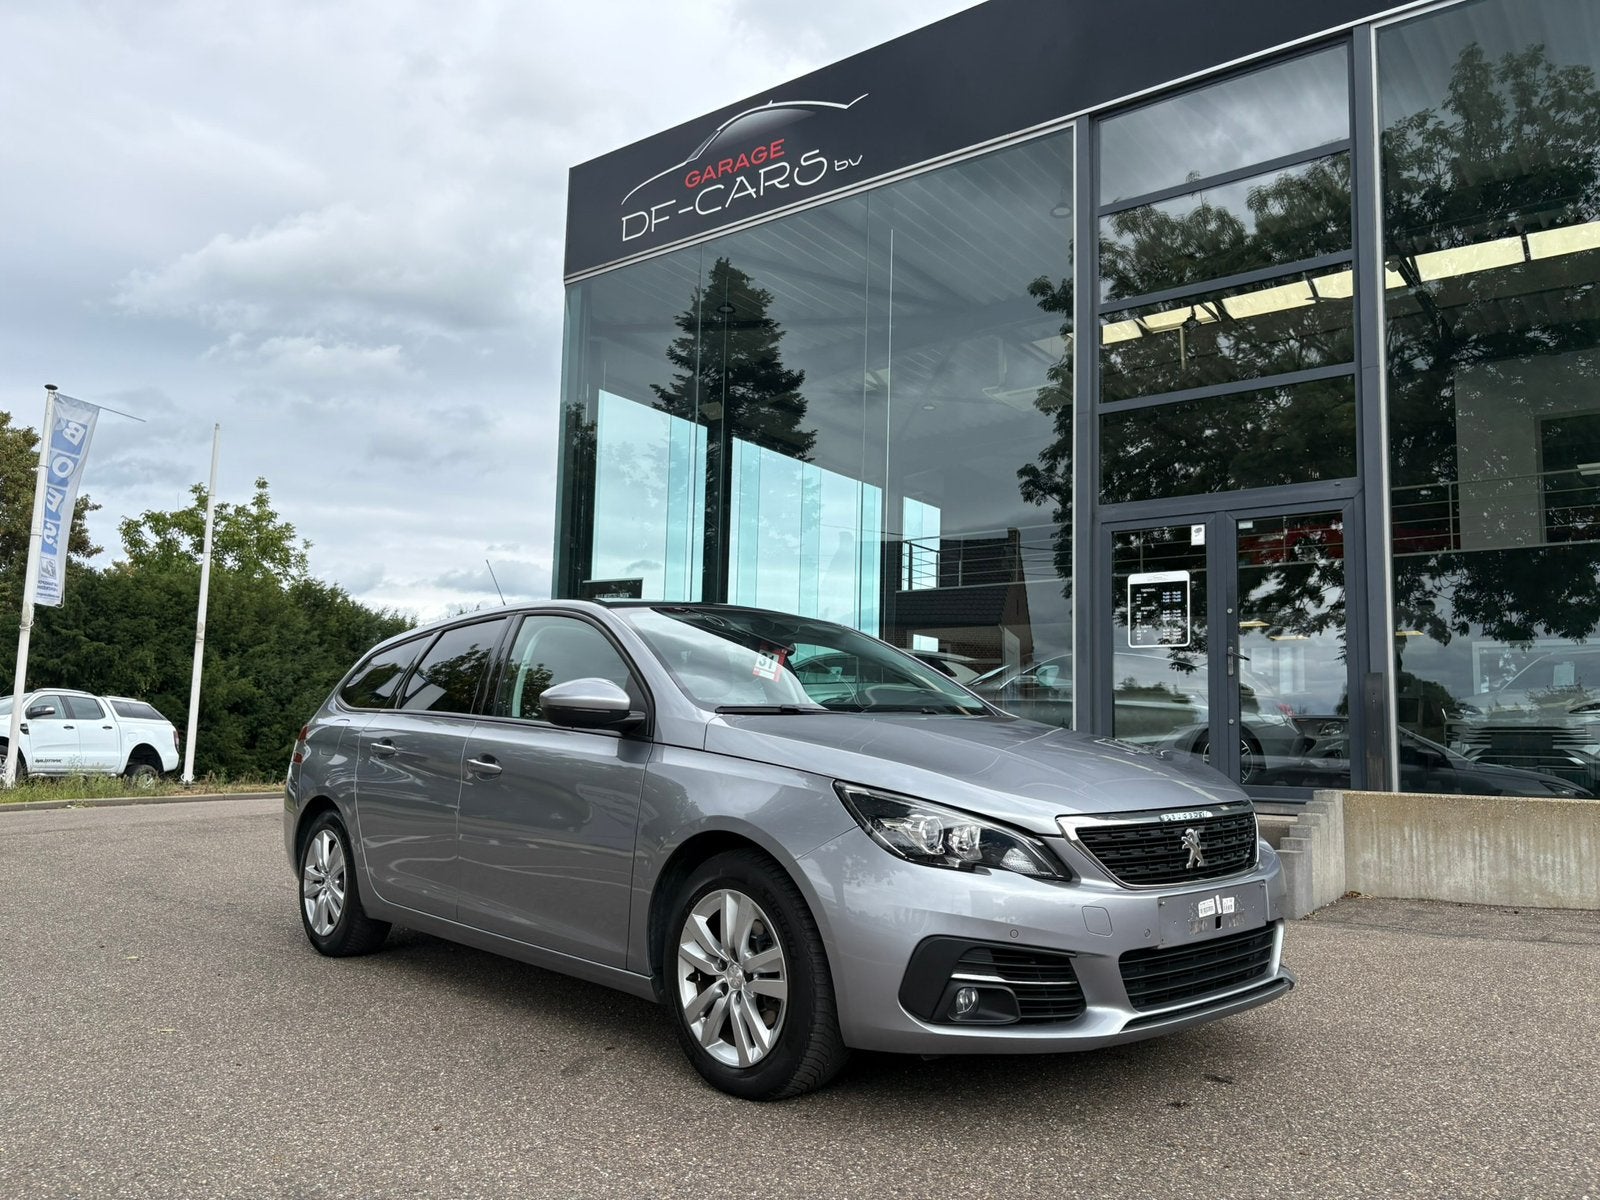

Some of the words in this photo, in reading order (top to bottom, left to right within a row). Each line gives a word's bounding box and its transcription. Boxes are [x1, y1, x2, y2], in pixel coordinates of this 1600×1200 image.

[621, 149, 828, 242] DF-CARS
[834, 154, 863, 171] bv
[684, 138, 785, 189] GARAGE
